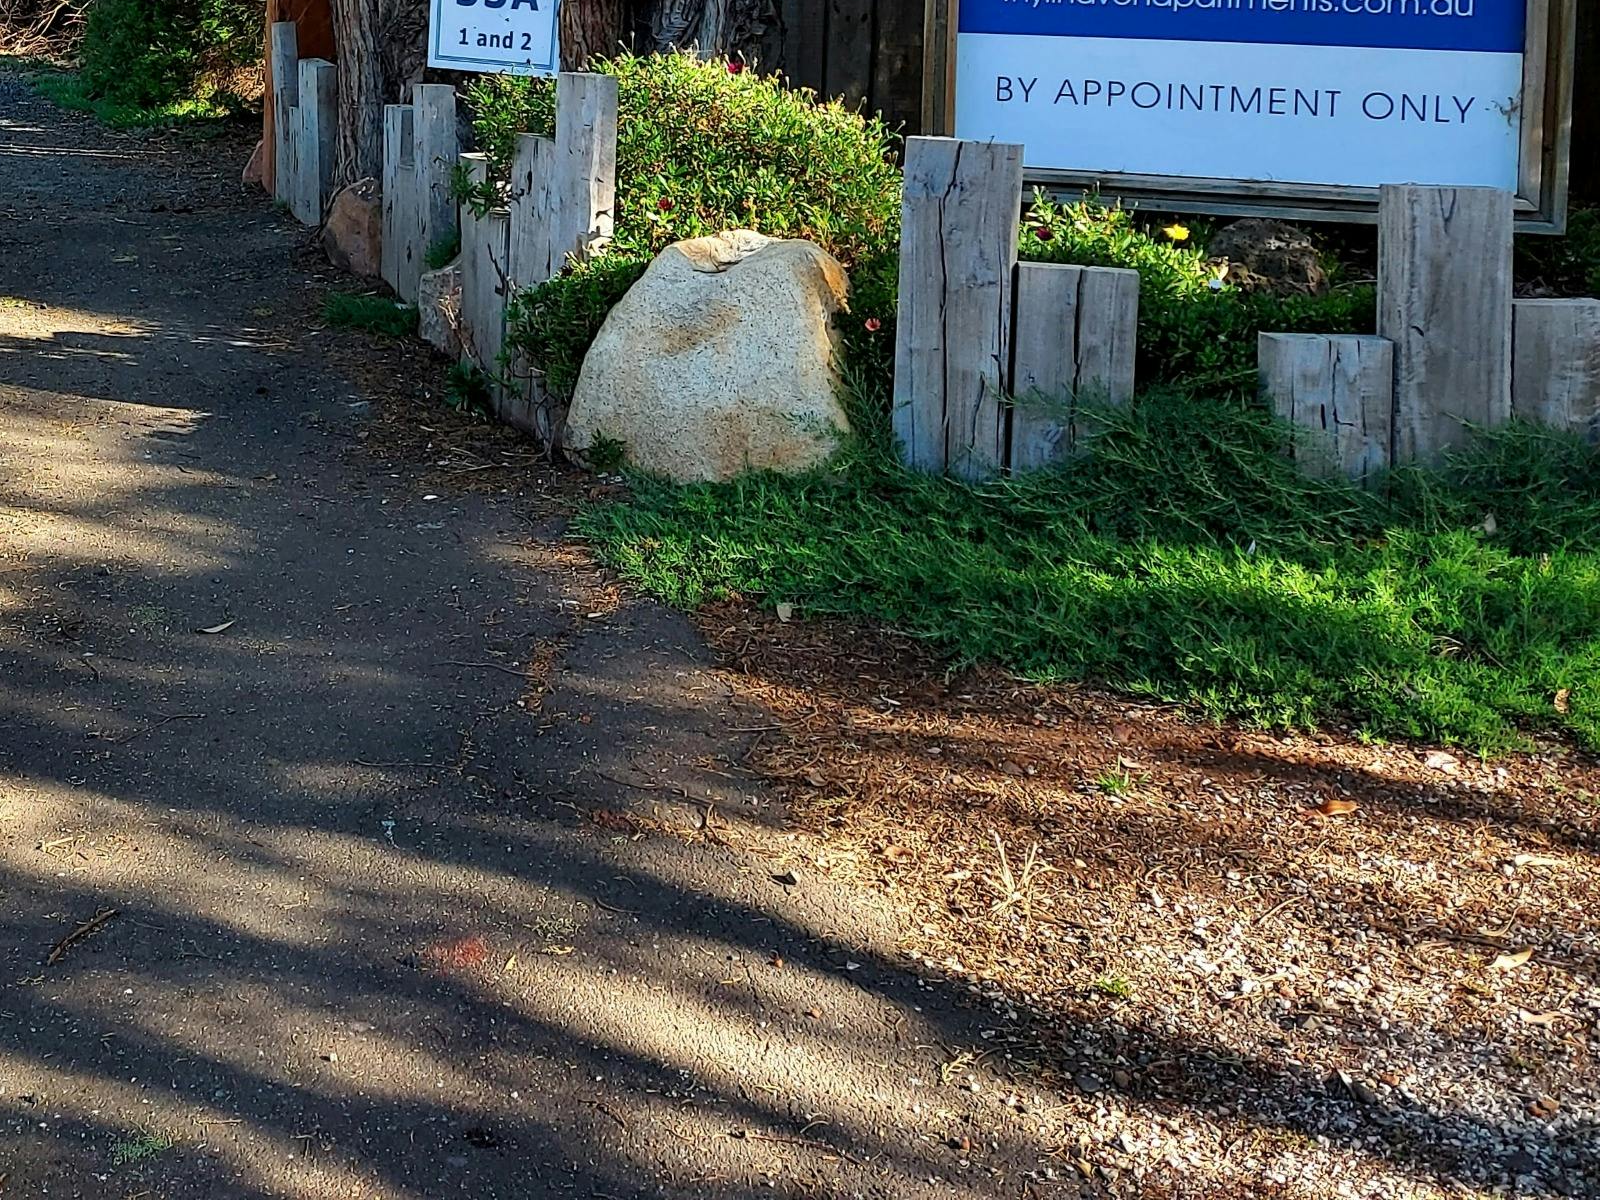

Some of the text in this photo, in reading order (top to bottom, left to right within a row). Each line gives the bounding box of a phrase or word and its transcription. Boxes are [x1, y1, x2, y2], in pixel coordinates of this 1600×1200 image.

[458, 28, 531, 50] 1 and 2
[996, 76, 1476, 124] BY APPOINTMENT ONLY
